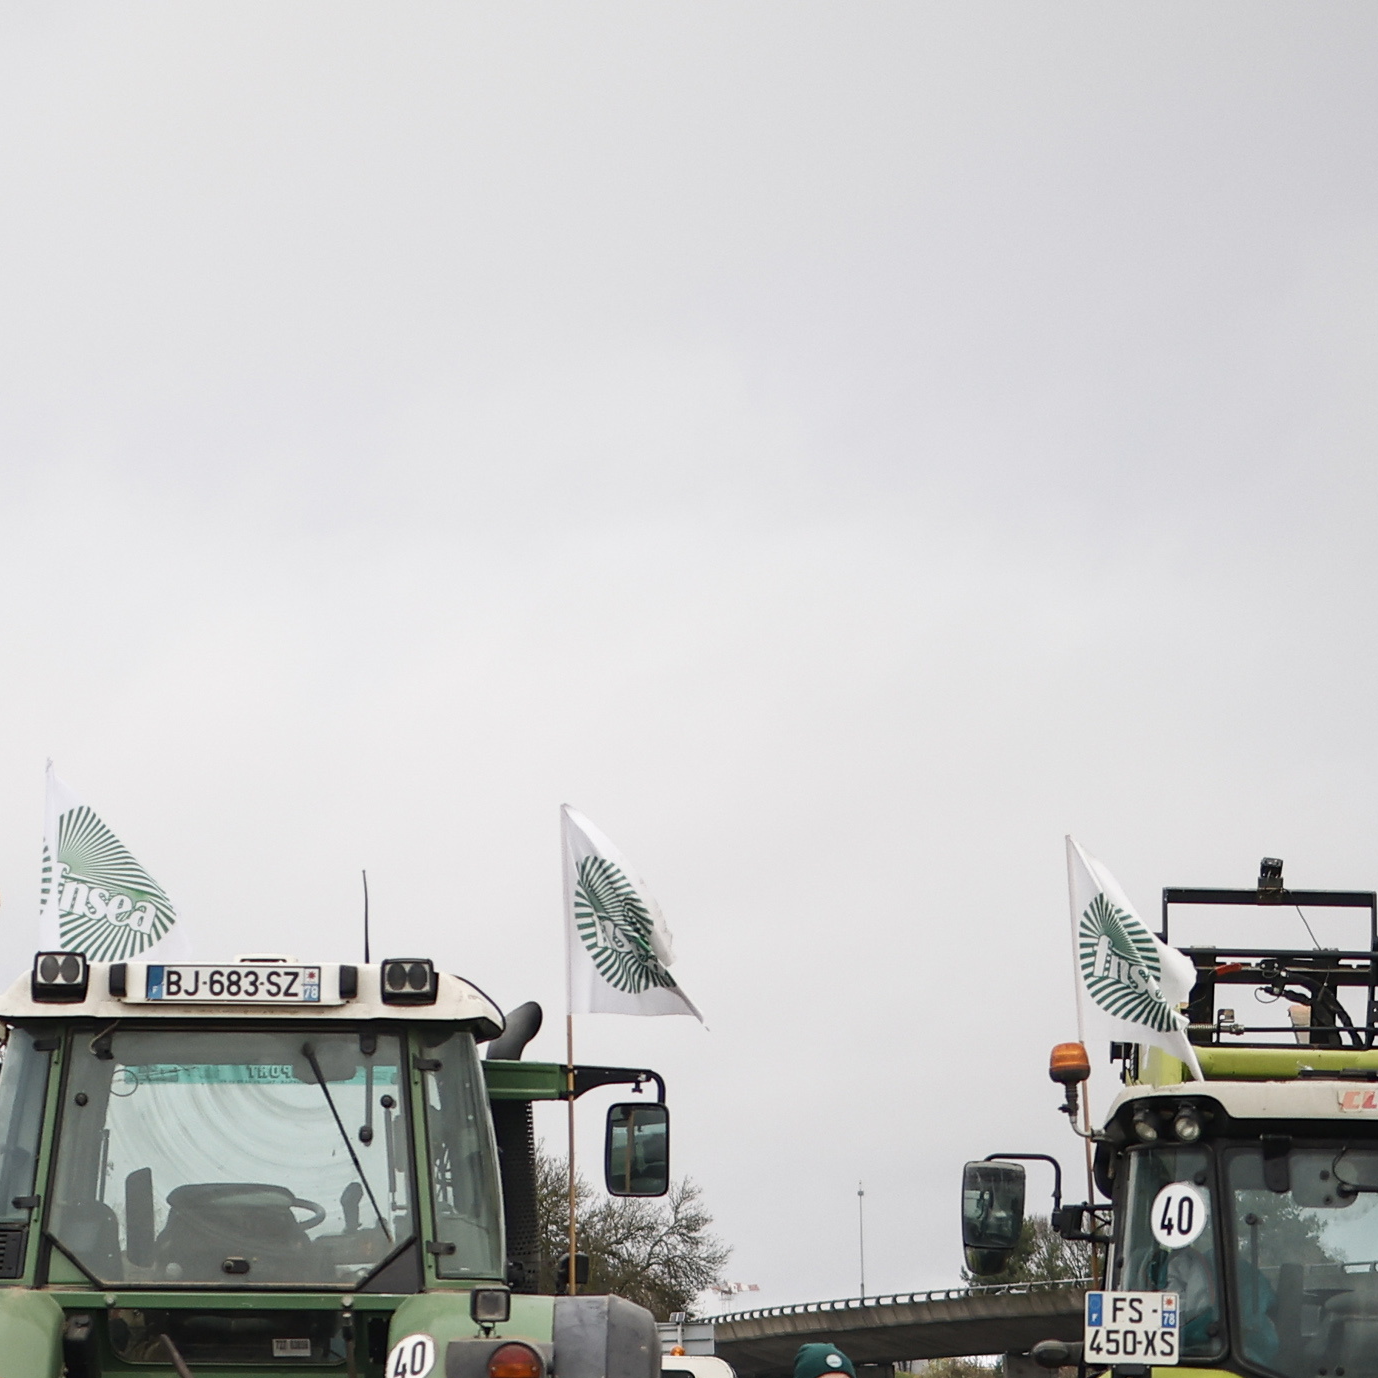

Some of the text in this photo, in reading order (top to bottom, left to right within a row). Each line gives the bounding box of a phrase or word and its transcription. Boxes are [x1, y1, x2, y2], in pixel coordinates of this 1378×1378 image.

[165, 970, 300, 997] BJ-683-SZ
[304, 986, 319, 999] 78
[1160, 1196, 1194, 1236] 40
[1089, 1329, 1175, 1357] 450-XS
